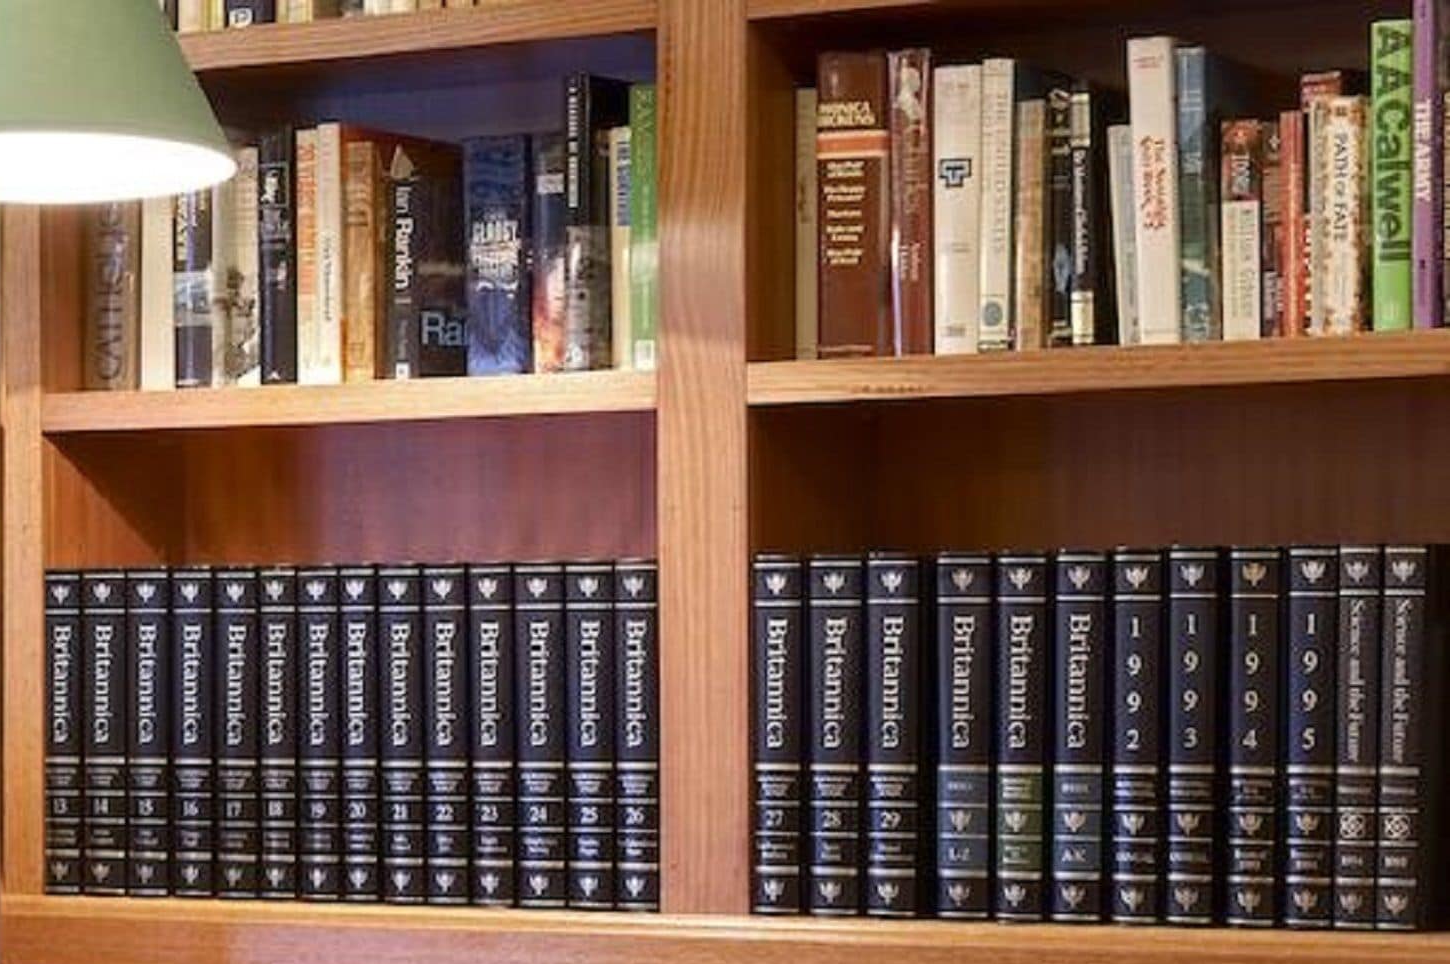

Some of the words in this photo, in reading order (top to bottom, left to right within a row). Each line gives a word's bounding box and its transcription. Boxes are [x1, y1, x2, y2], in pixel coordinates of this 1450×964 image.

[1376, 26, 1411, 59] A
[1376, 63, 1411, 97] A
[1415, 98, 1431, 137] THE
[1335, 133, 1349, 178] PATH
[1415, 140, 1431, 202] ARMY
[395, 186, 412, 214] Ian
[1376, 99, 1412, 262] Calwell
[1335, 203, 1349, 242] FATE
[395, 217, 414, 289] Rankin
[421, 312, 468, 347] Ra
[54, 626, 70, 743] Britannica
[94, 626, 112, 743] Britannica
[138, 625, 156, 743] Britannica
[183, 625, 202, 744] Britannica
[228, 625, 246, 745] Britannica
[268, 624, 286, 745] Britannica
[309, 624, 328, 745] Britannica
[348, 623, 367, 746] Britannica
[391, 624, 410, 746] Britannica
[436, 623, 455, 746] Britannica
[480, 622, 499, 746] Britannica
[530, 622, 549, 746] Britannica
[581, 621, 600, 747] Britannica
[626, 621, 646, 748] Britannica
[767, 619, 787, 748] Britannica
[823, 619, 846, 748] Britannica
[882, 618, 903, 748] Britannica
[953, 616, 974, 748] Britannica
[1008, 616, 1032, 748] Britannica
[1068, 615, 1091, 748] Britannica
[1126, 617, 1142, 750] 1992
[1183, 614, 1198, 749] 1993
[1242, 614, 1259, 749] 1994
[1299, 613, 1318, 750] 1995
[1349, 658, 1366, 686] and
[1395, 657, 1411, 686] and
[1349, 687, 1366, 712] the
[1394, 687, 1411, 712] the
[53, 798, 68, 814] 13
[93, 798, 109, 814] 14
[138, 798, 154, 816] 15
[183, 800, 199, 816] 16
[227, 801, 242, 817] 17
[269, 801, 284, 817] 18
[310, 801, 327, 818] 19
[349, 802, 367, 819] 20
[393, 803, 409, 821] 21
[436, 803, 455, 821] 22
[480, 805, 499, 822] 23
[529, 806, 548, 822] 24
[579, 806, 599, 824] 25
[625, 807, 645, 825] 26
[765, 809, 784, 827] 27
[822, 810, 842, 828] 28
[880, 811, 902, 829] 29
